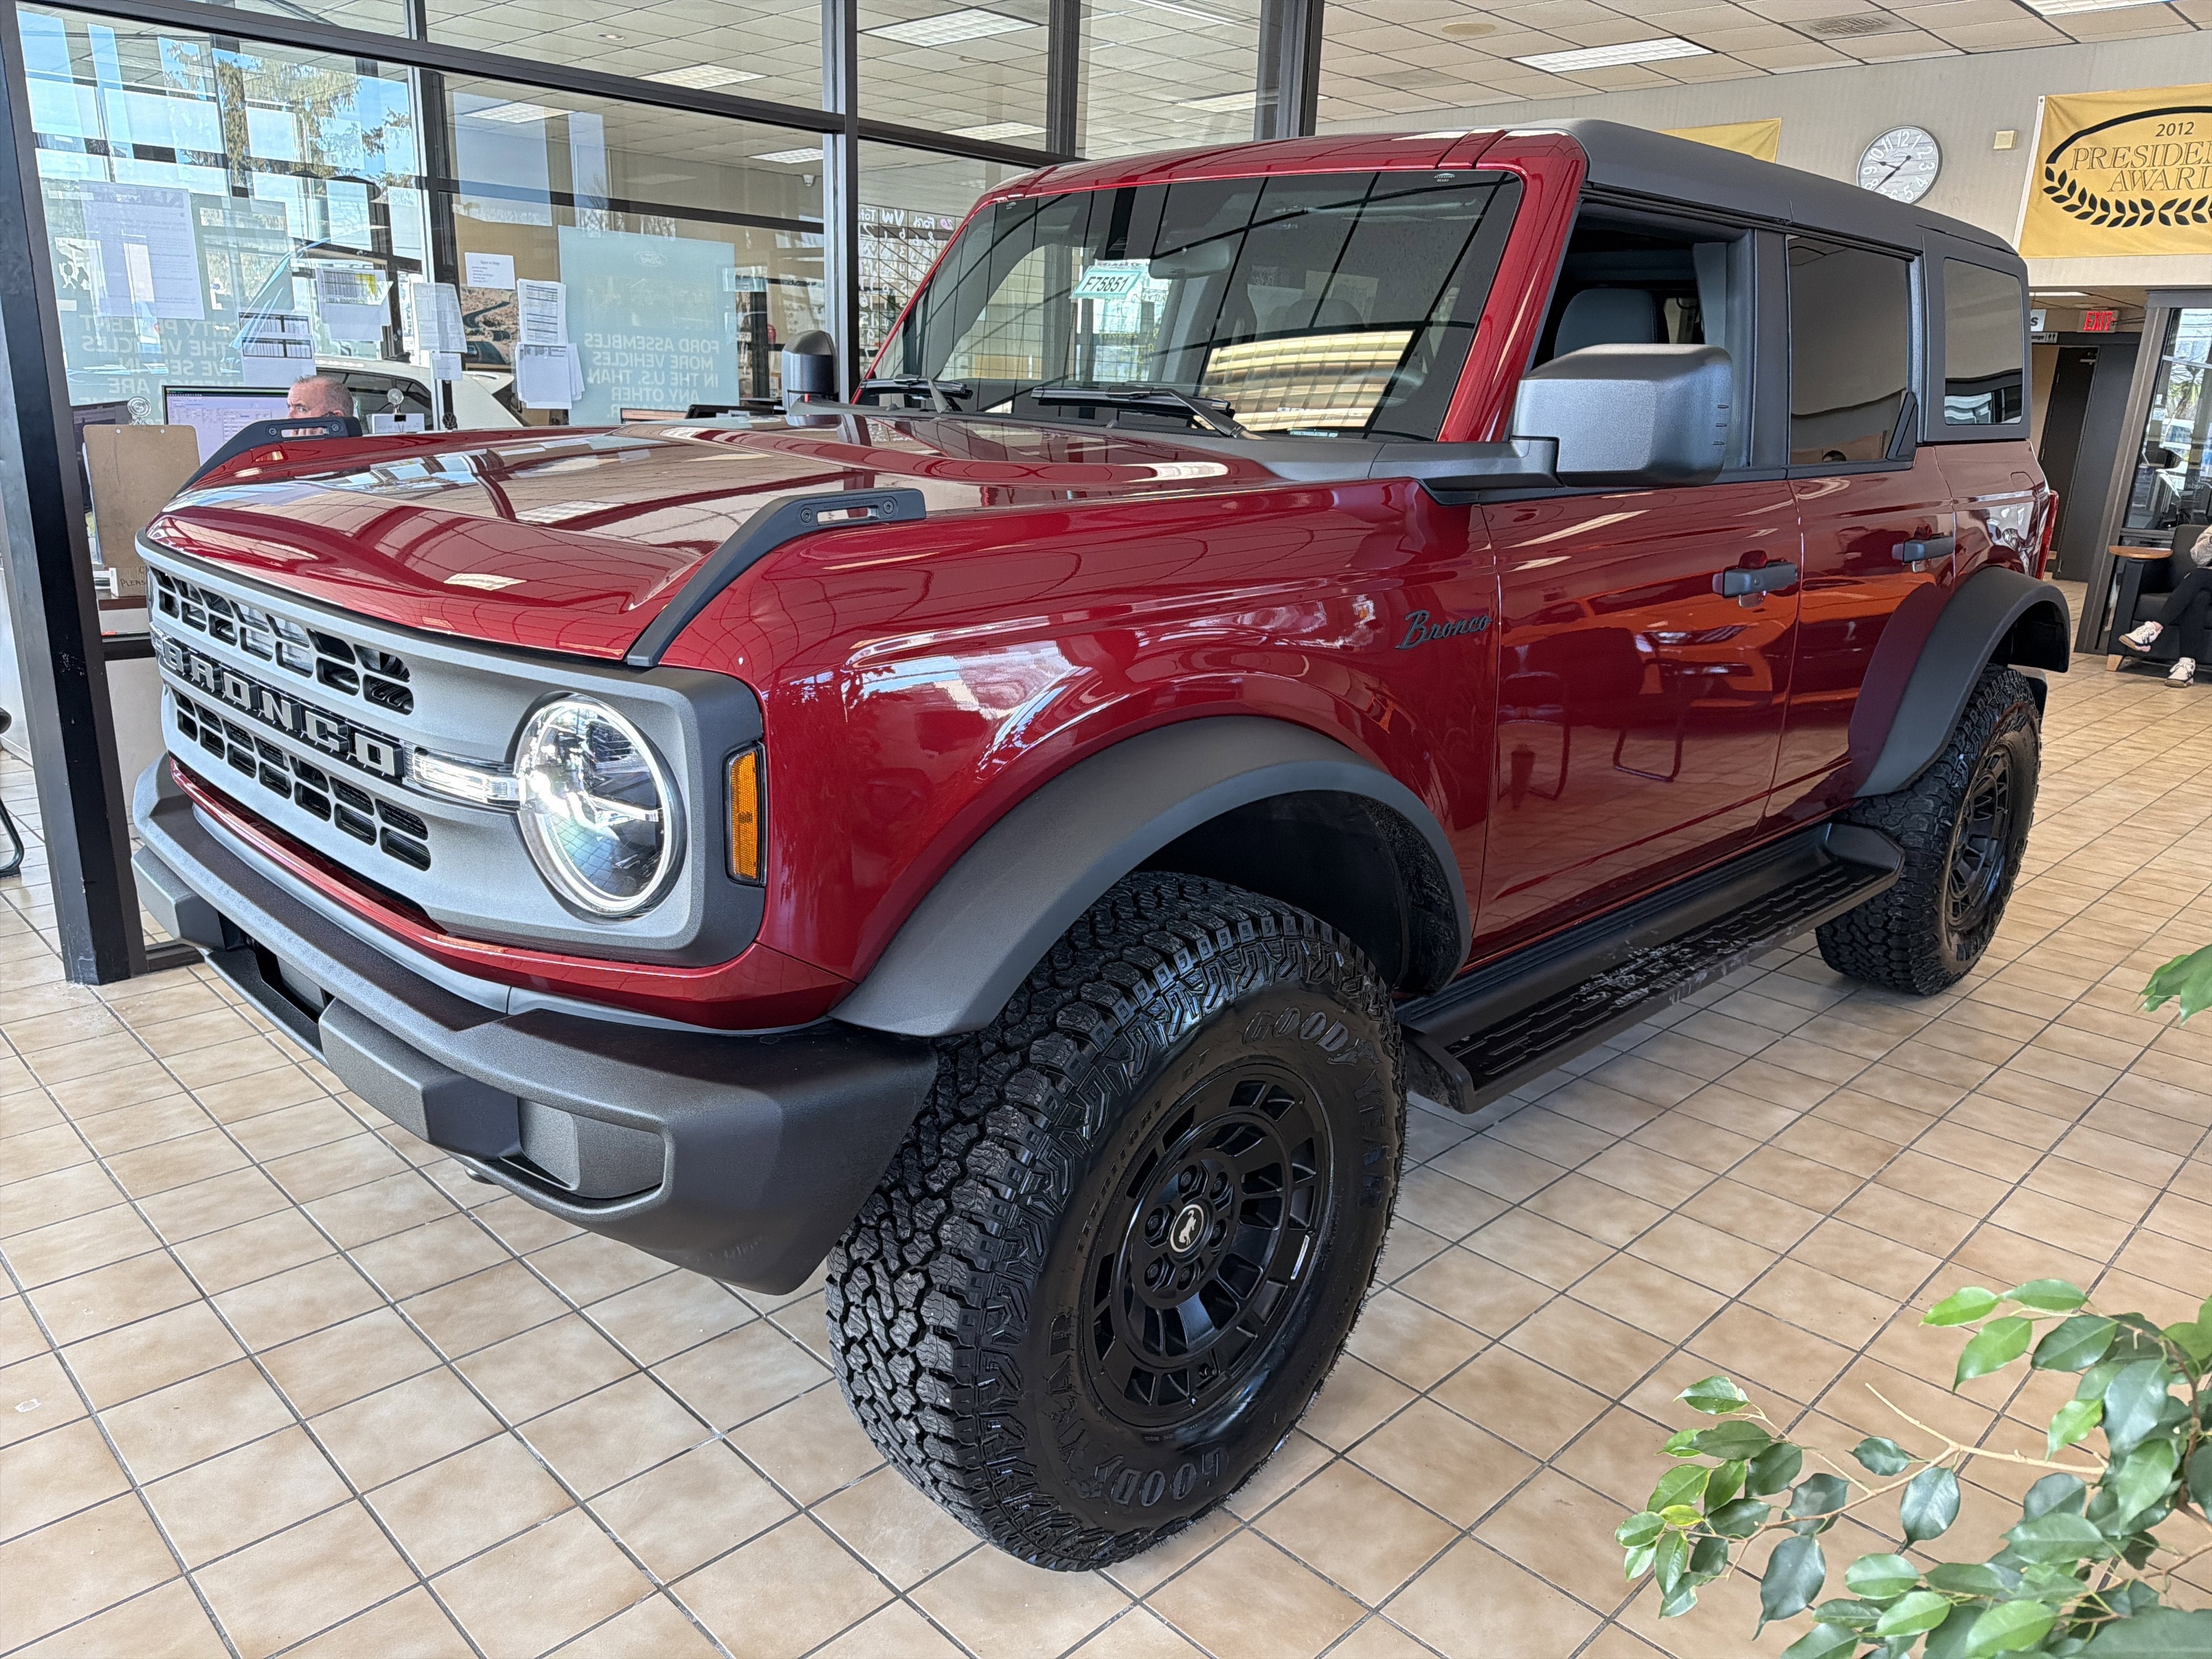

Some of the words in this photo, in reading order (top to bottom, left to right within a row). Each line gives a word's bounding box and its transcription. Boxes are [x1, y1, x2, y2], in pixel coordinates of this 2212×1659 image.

[2155, 121, 2194, 137] 2012
[1881, 136, 1894, 153] 11
[1897, 131, 1910, 147] 12
[1911, 134, 1923, 149] 1
[1867, 148, 1884, 161] 10
[1916, 145, 1933, 160] 2
[1862, 166, 1878, 175] 9
[1918, 162, 1936, 171] 3
[1915, 176, 1929, 188] 4
[1903, 184, 1914, 201] 5
[1081, 276, 1130, 292] F75851
[2084, 311, 2113, 331] EXIT
[1395, 610, 1493, 650] Bronco
[162, 637, 404, 781] BRONCO
